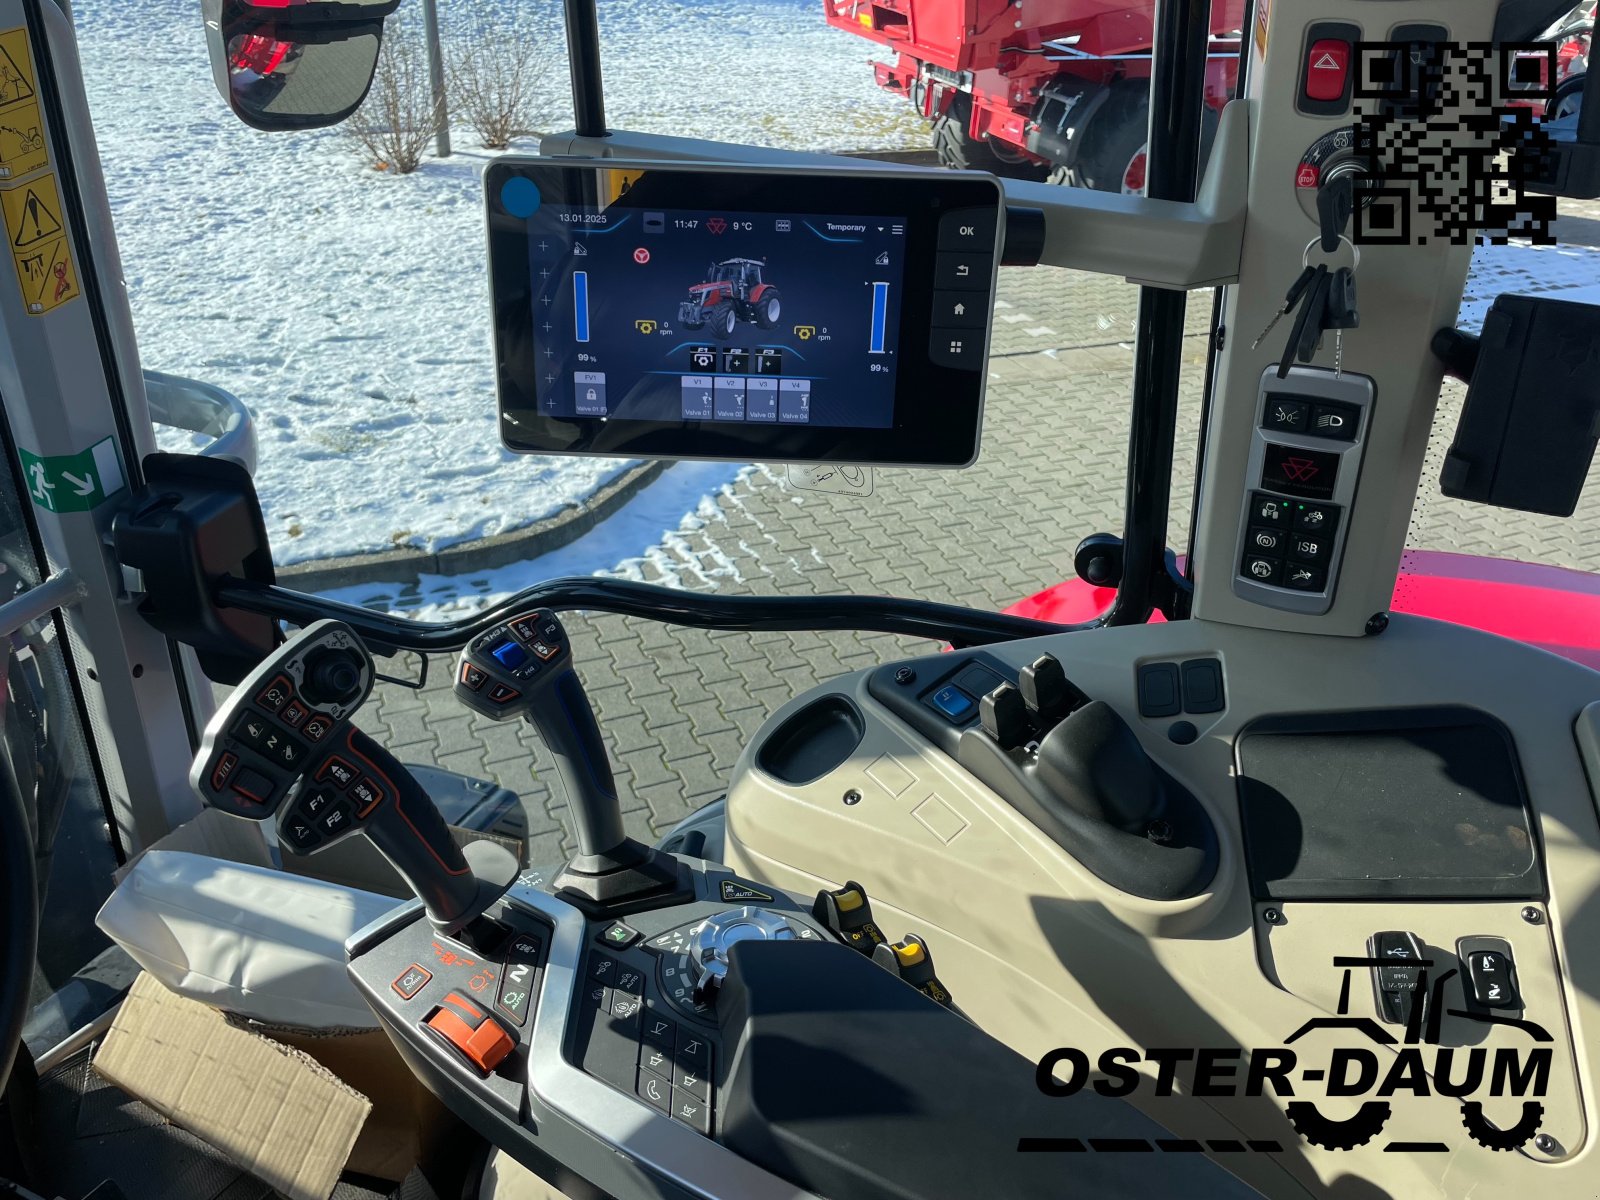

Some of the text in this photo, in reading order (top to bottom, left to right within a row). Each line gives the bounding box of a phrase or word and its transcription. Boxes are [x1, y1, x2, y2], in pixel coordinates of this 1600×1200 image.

[559, 213, 607, 223] 13.01.2025
[674, 220, 698, 229] 11:47
[733, 221, 752, 230] 9 °C
[827, 223, 866, 233] Temporary
[959, 226, 974, 236] OK
[578, 353, 589, 362] 99
[870, 364, 881, 372] 99
[1297, 541, 1318, 554] ISB
[545, 624, 556, 635] F3
[267, 735, 278, 749] N
[309, 794, 325, 811] F1
[326, 810, 342, 828] F2
[509, 963, 529, 983] N
[665, 967, 675, 977] 8
[626, 975, 638, 989] AUTO
[675, 988, 685, 998] 9
[511, 992, 525, 1010] AUTO
[624, 1003, 637, 1018] AUTO
